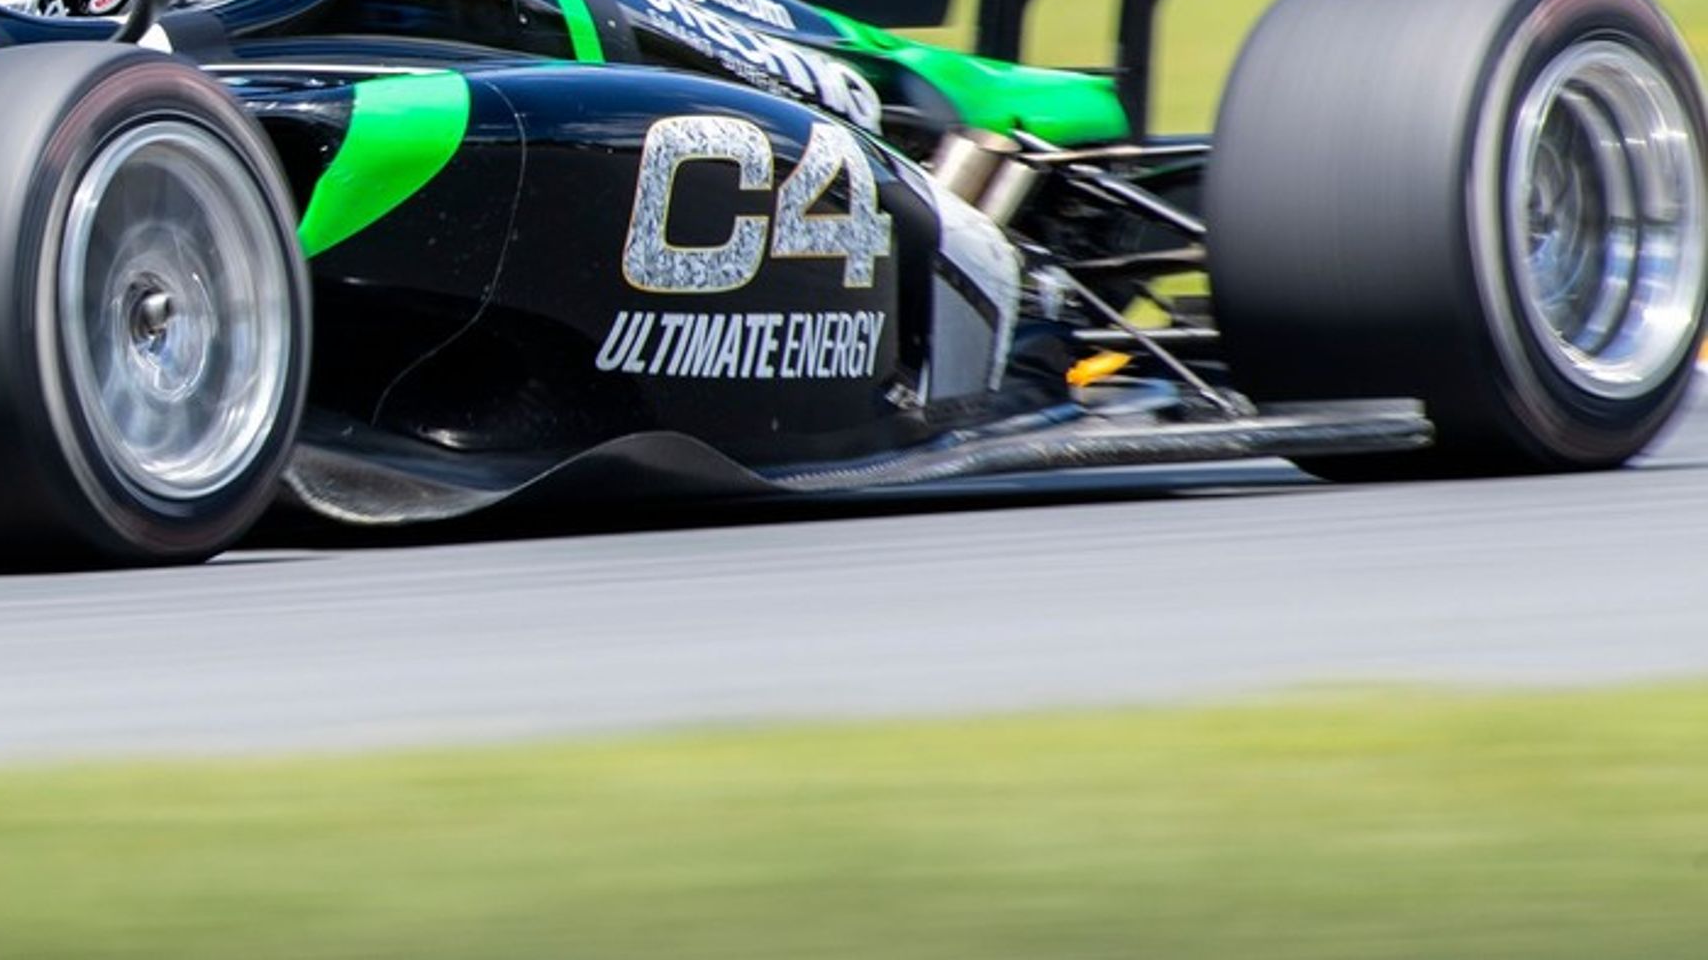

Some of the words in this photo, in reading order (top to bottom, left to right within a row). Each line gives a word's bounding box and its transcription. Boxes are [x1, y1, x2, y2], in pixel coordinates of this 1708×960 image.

[621, 116, 892, 294] C4
[595, 310, 789, 379] ULTIMATE
[779, 310, 886, 379] ENERGY
